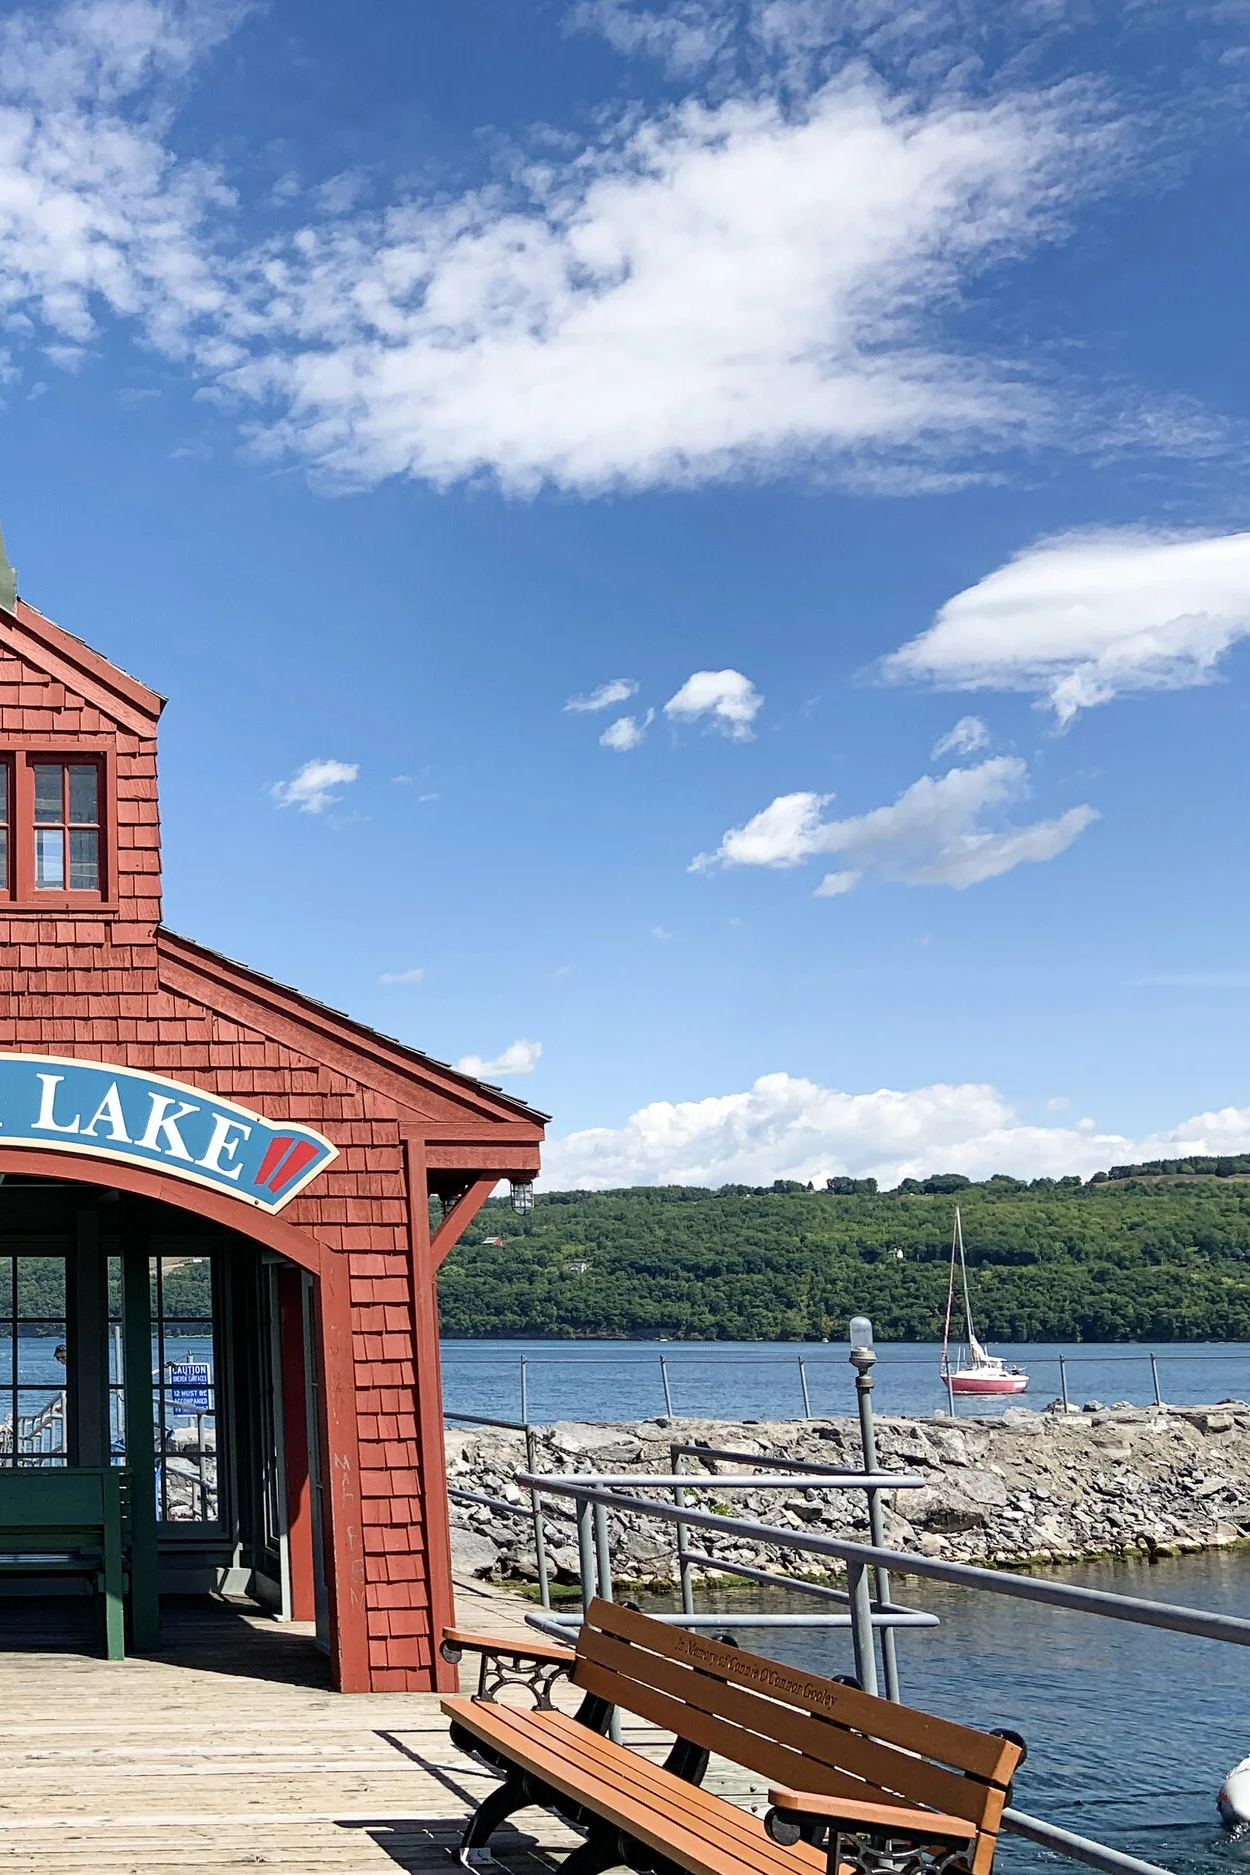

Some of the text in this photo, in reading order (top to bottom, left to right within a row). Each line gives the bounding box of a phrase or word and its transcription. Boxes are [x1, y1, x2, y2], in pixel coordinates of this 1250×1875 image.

[31, 1072, 253, 1178] LAKE
[172, 1365, 206, 1375] CAUTION
[685, 1641, 716, 1666] Memory
[717, 1654, 730, 1668] of
[728, 1656, 760, 1679] Connie
[759, 1668, 803, 1694] O'Connor
[802, 1683, 837, 1710] Gooley
